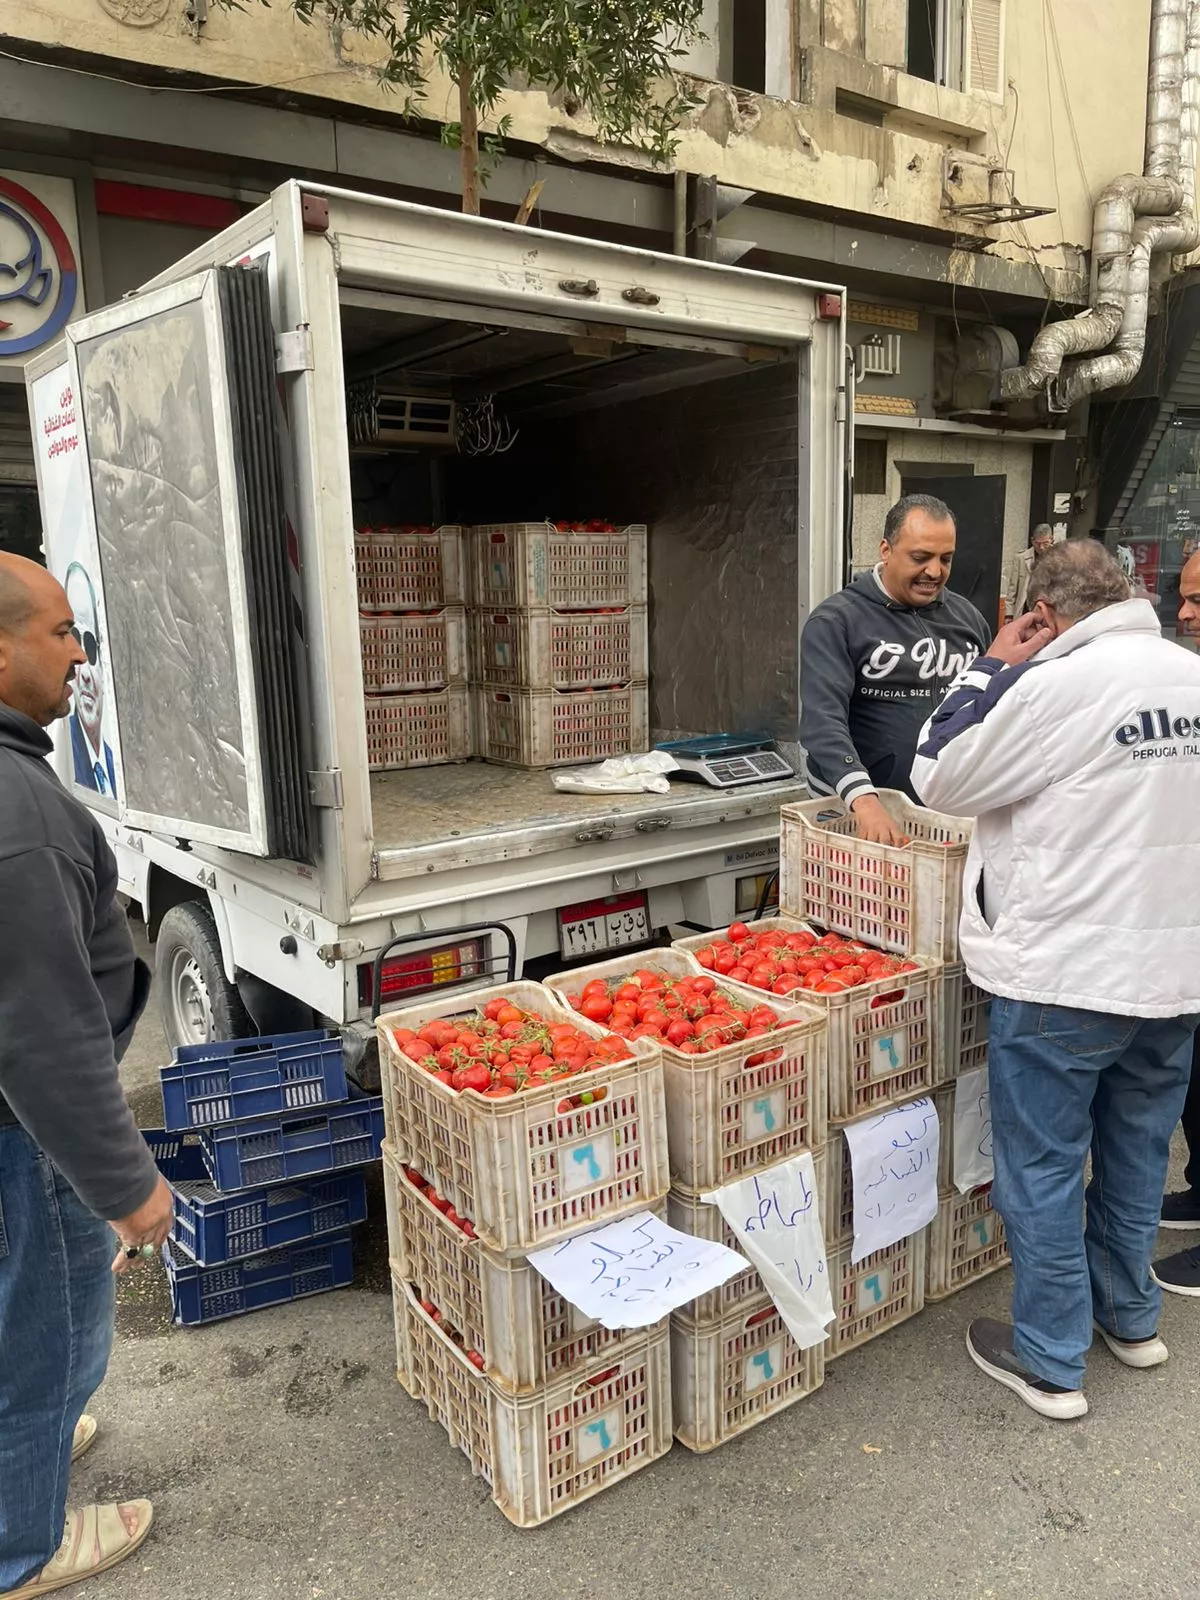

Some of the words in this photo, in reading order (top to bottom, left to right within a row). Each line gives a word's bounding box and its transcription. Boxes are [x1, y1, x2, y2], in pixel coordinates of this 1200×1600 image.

[861, 639, 905, 679] G
[861, 687, 906, 698] OFFICIAL
[910, 688, 931, 697] SIZE
[1132, 746, 1178, 761] PERUGIA
[884, 1113, 937, 1160] كيلو
[745, 1171, 812, 1232] طماطم
